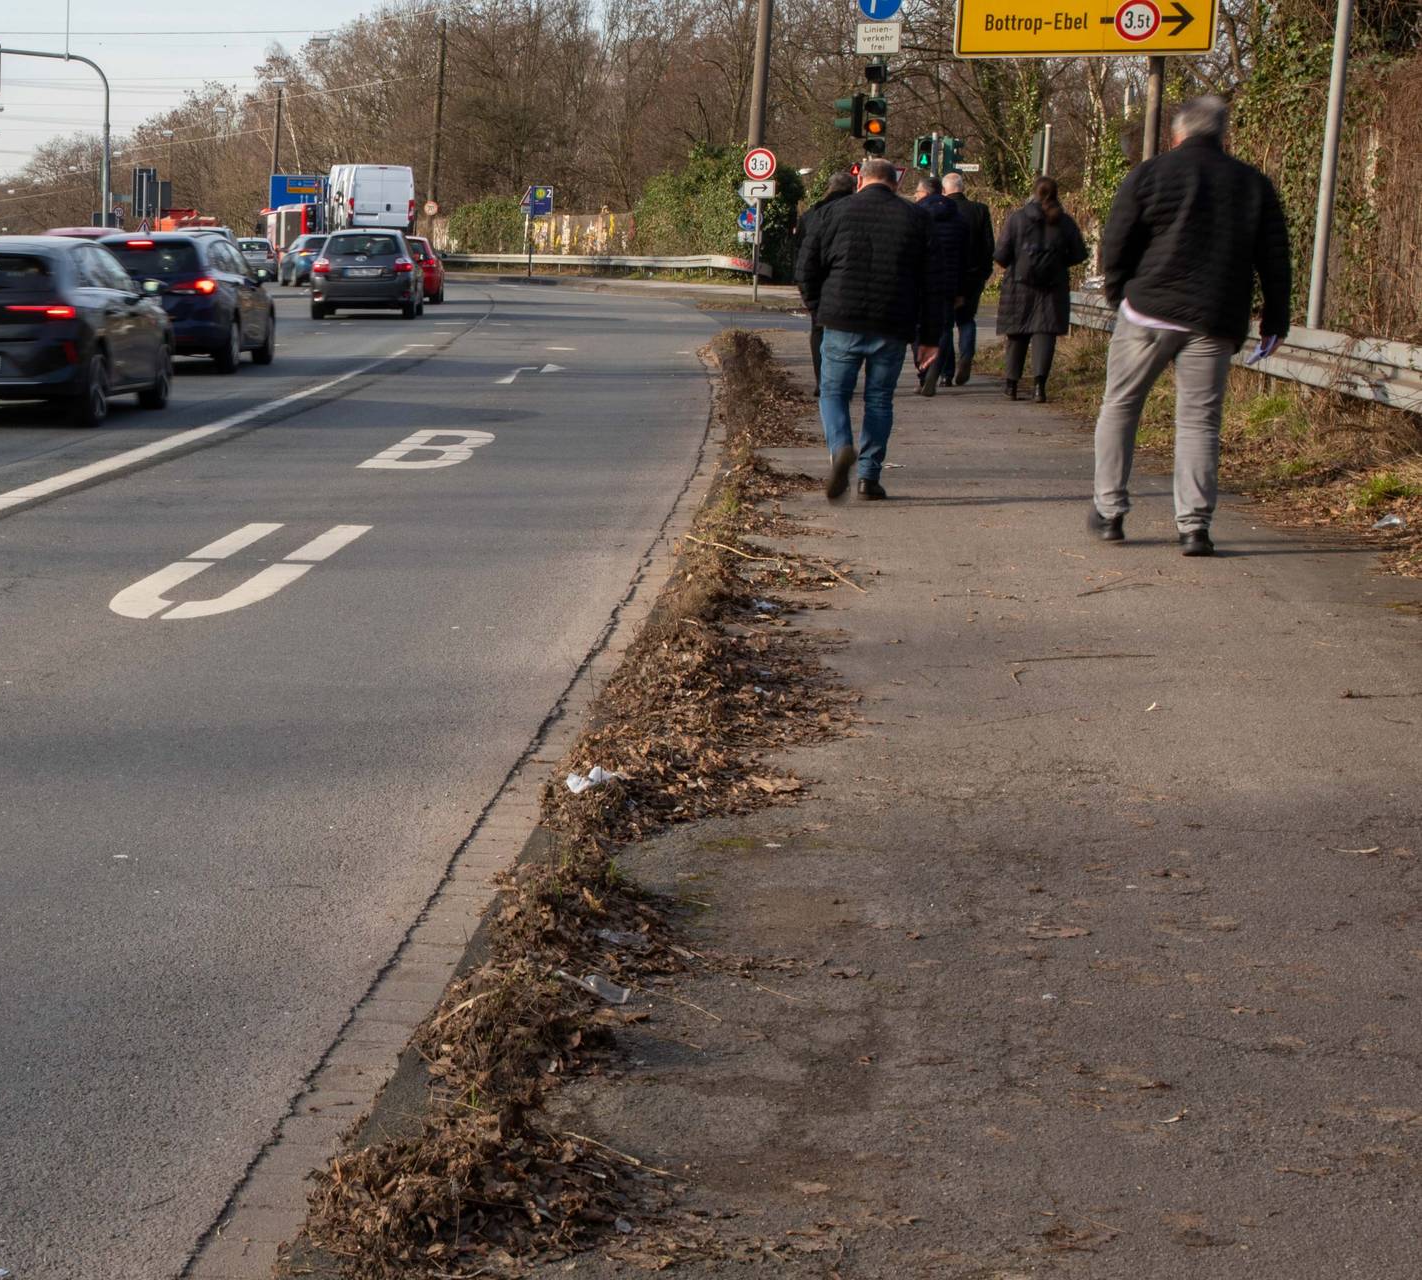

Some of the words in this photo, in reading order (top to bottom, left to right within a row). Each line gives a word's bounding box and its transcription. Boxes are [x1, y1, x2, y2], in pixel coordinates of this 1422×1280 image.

[864, 25, 892, 34] Linien-
[985, 12, 1088, 35] Bottrop-Ebel
[862, 34, 894, 43] verkehr
[546, 189, 552, 198] 2
[355, 429, 495, 469] B
[109, 522, 373, 619] U
